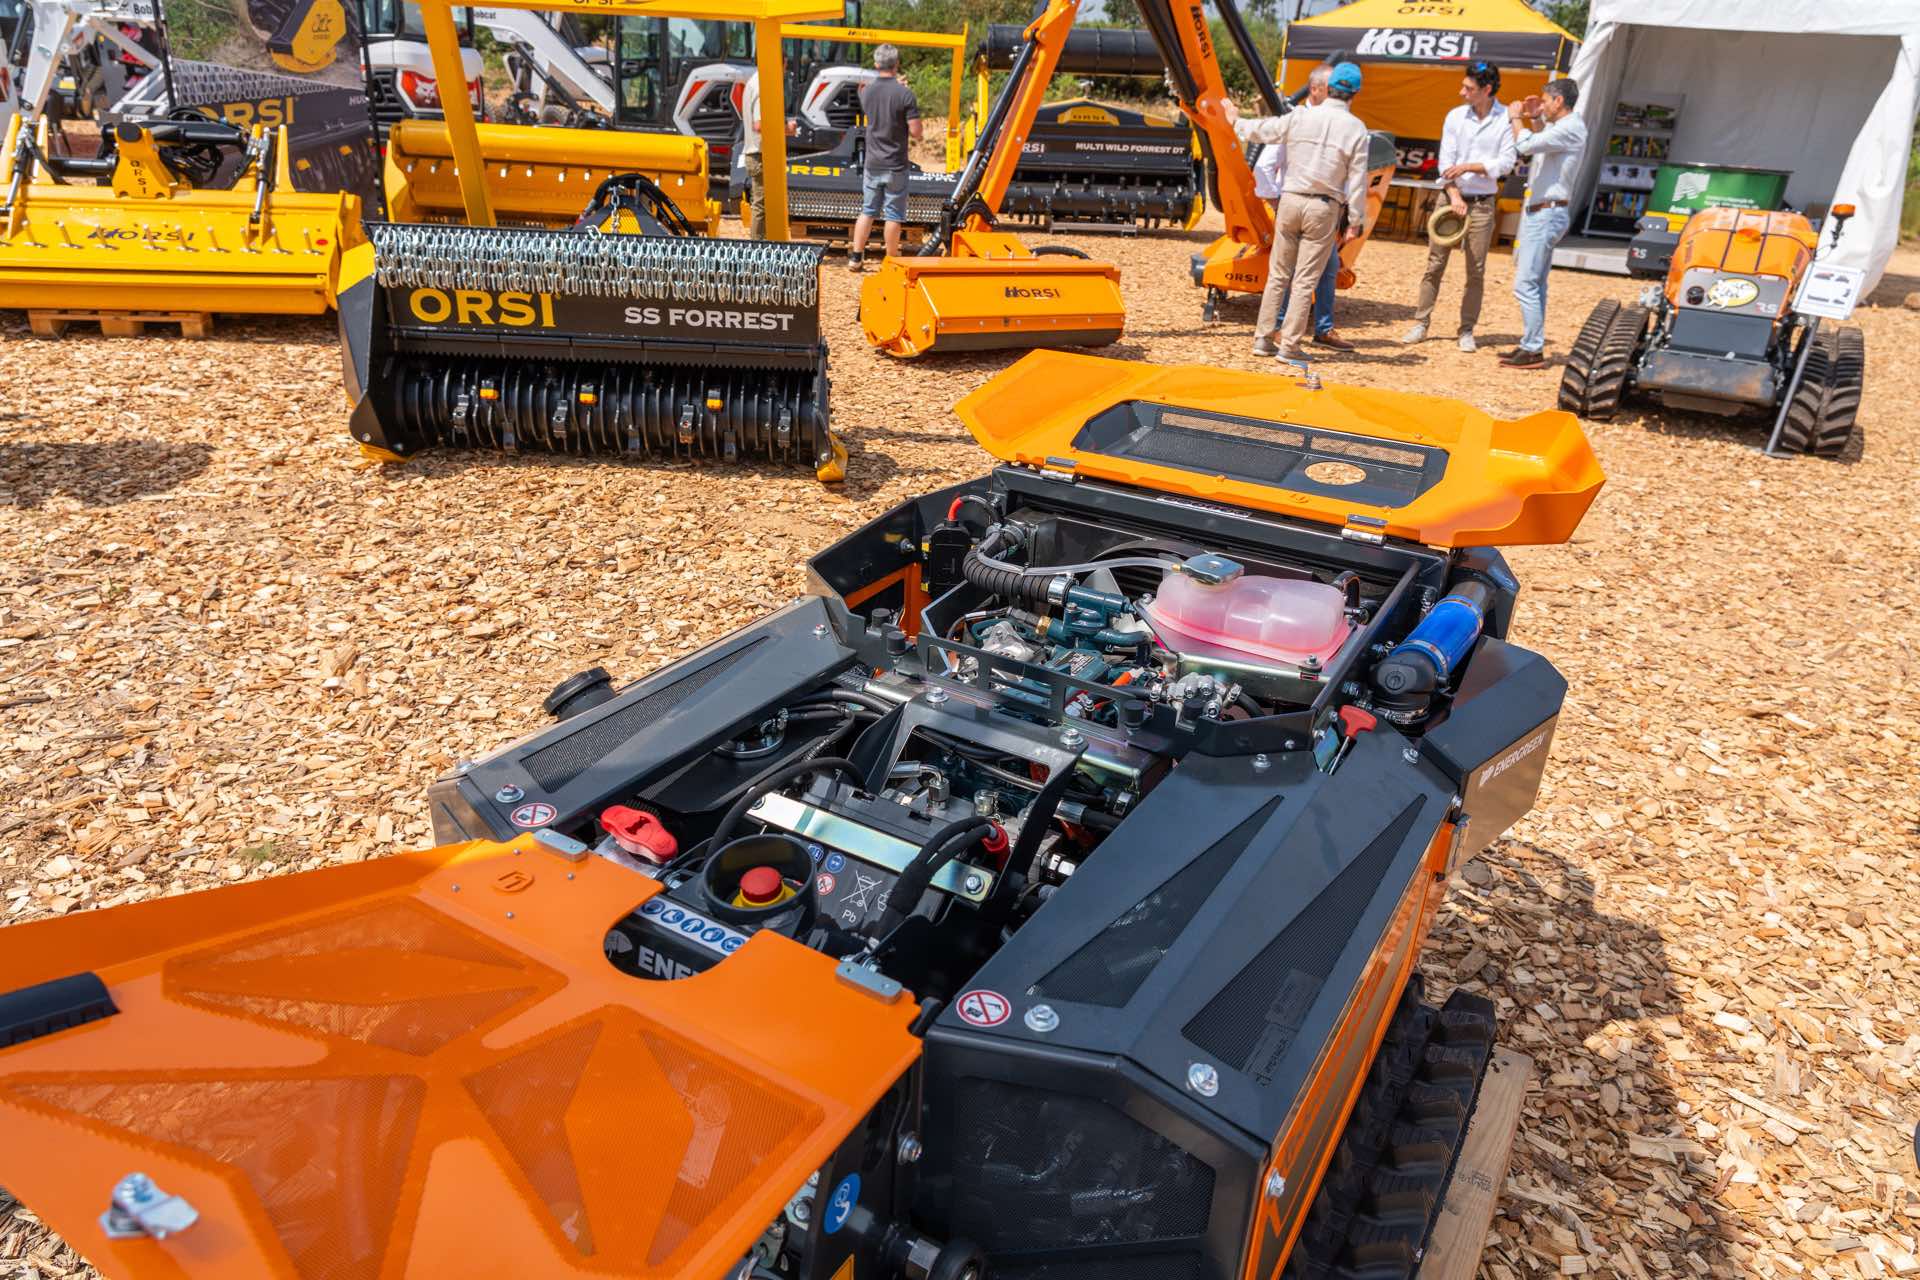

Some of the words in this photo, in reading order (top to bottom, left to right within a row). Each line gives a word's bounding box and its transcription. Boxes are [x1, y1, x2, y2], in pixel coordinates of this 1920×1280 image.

[1022, 143, 1045, 153] RSI
[1075, 142, 1104, 151] MULTI
[1105, 144, 1129, 152] WILD
[1130, 145, 1171, 154] FORREST
[787, 164, 841, 177] RSI
[1224, 272, 1259, 283] ORSI
[409, 287, 557, 328] ORSI
[624, 306, 661, 325] SS
[668, 308, 794, 331] FORREST
[841, 908, 857, 923] Pb
